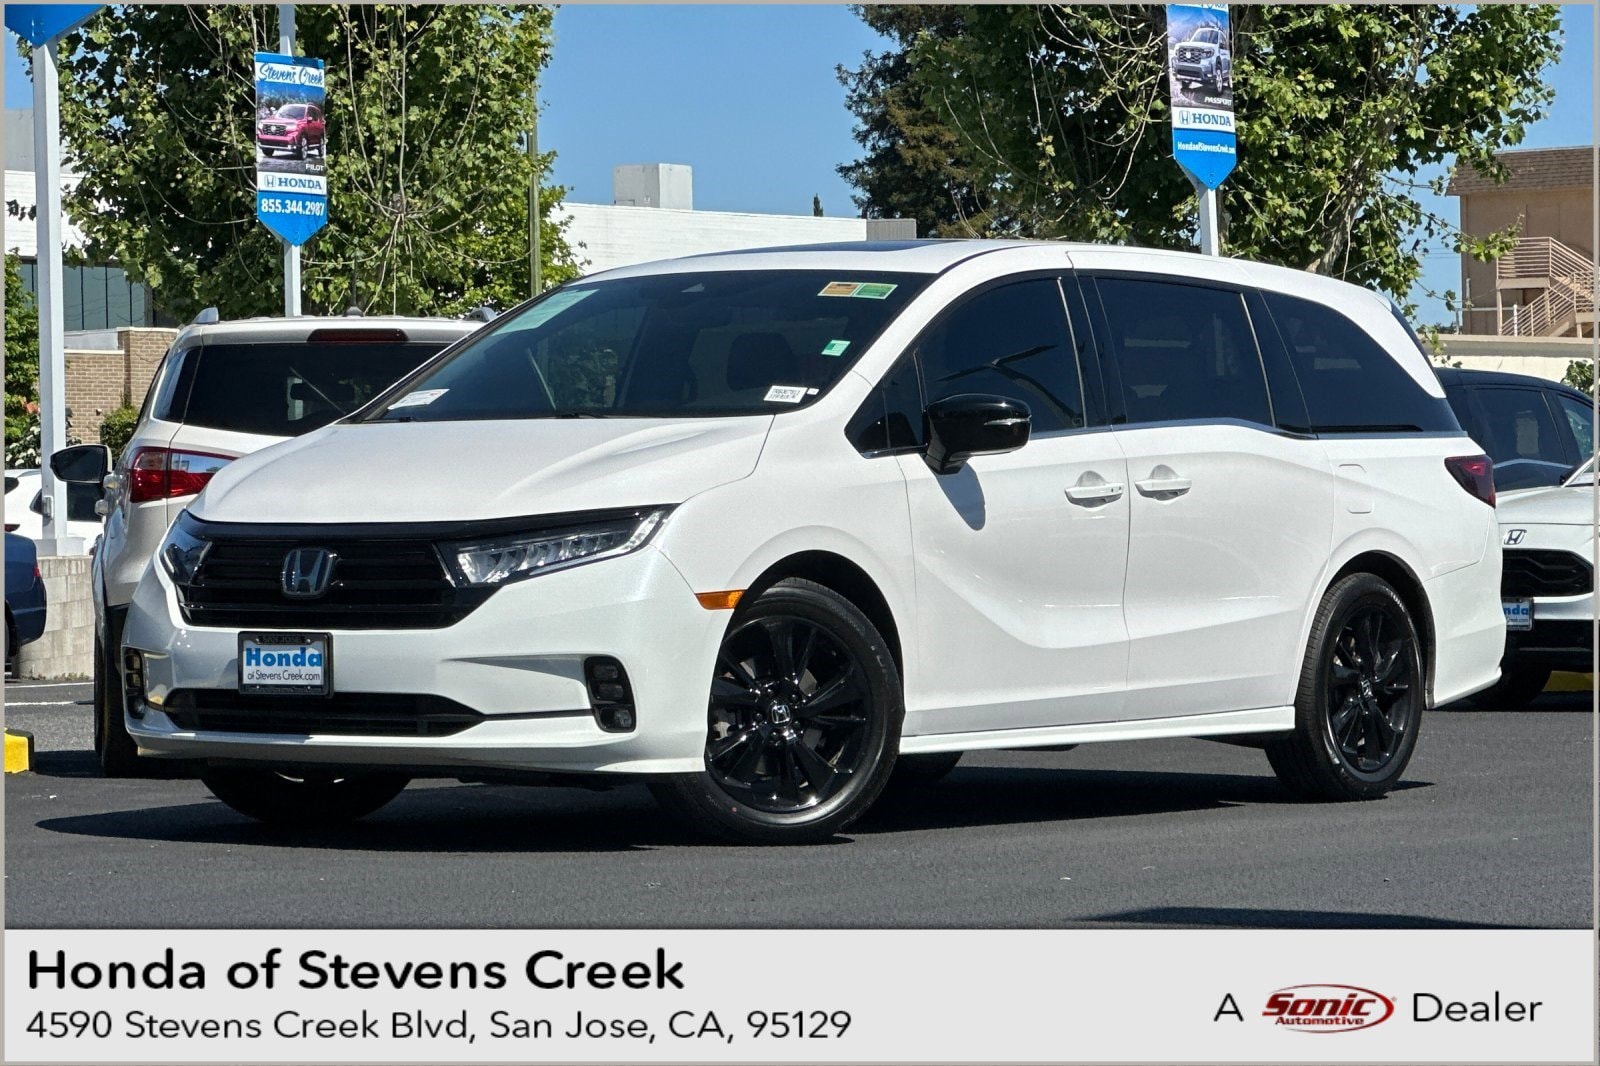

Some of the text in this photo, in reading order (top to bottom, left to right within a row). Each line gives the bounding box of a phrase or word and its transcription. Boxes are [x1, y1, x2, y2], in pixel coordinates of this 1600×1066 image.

[258, 63, 323, 85] Stevens Creek
[1204, 96, 1232, 106] PASSPORT
[1192, 113, 1232, 127] HONDA
[305, 163, 324, 171] PILOT
[277, 177, 322, 190] HONDA
[261, 198, 325, 216] 855.344.2987
[1503, 604, 1528, 615] nda
[246, 647, 322, 667] Honda
[247, 669, 321, 681] of Stevens Creek.com
